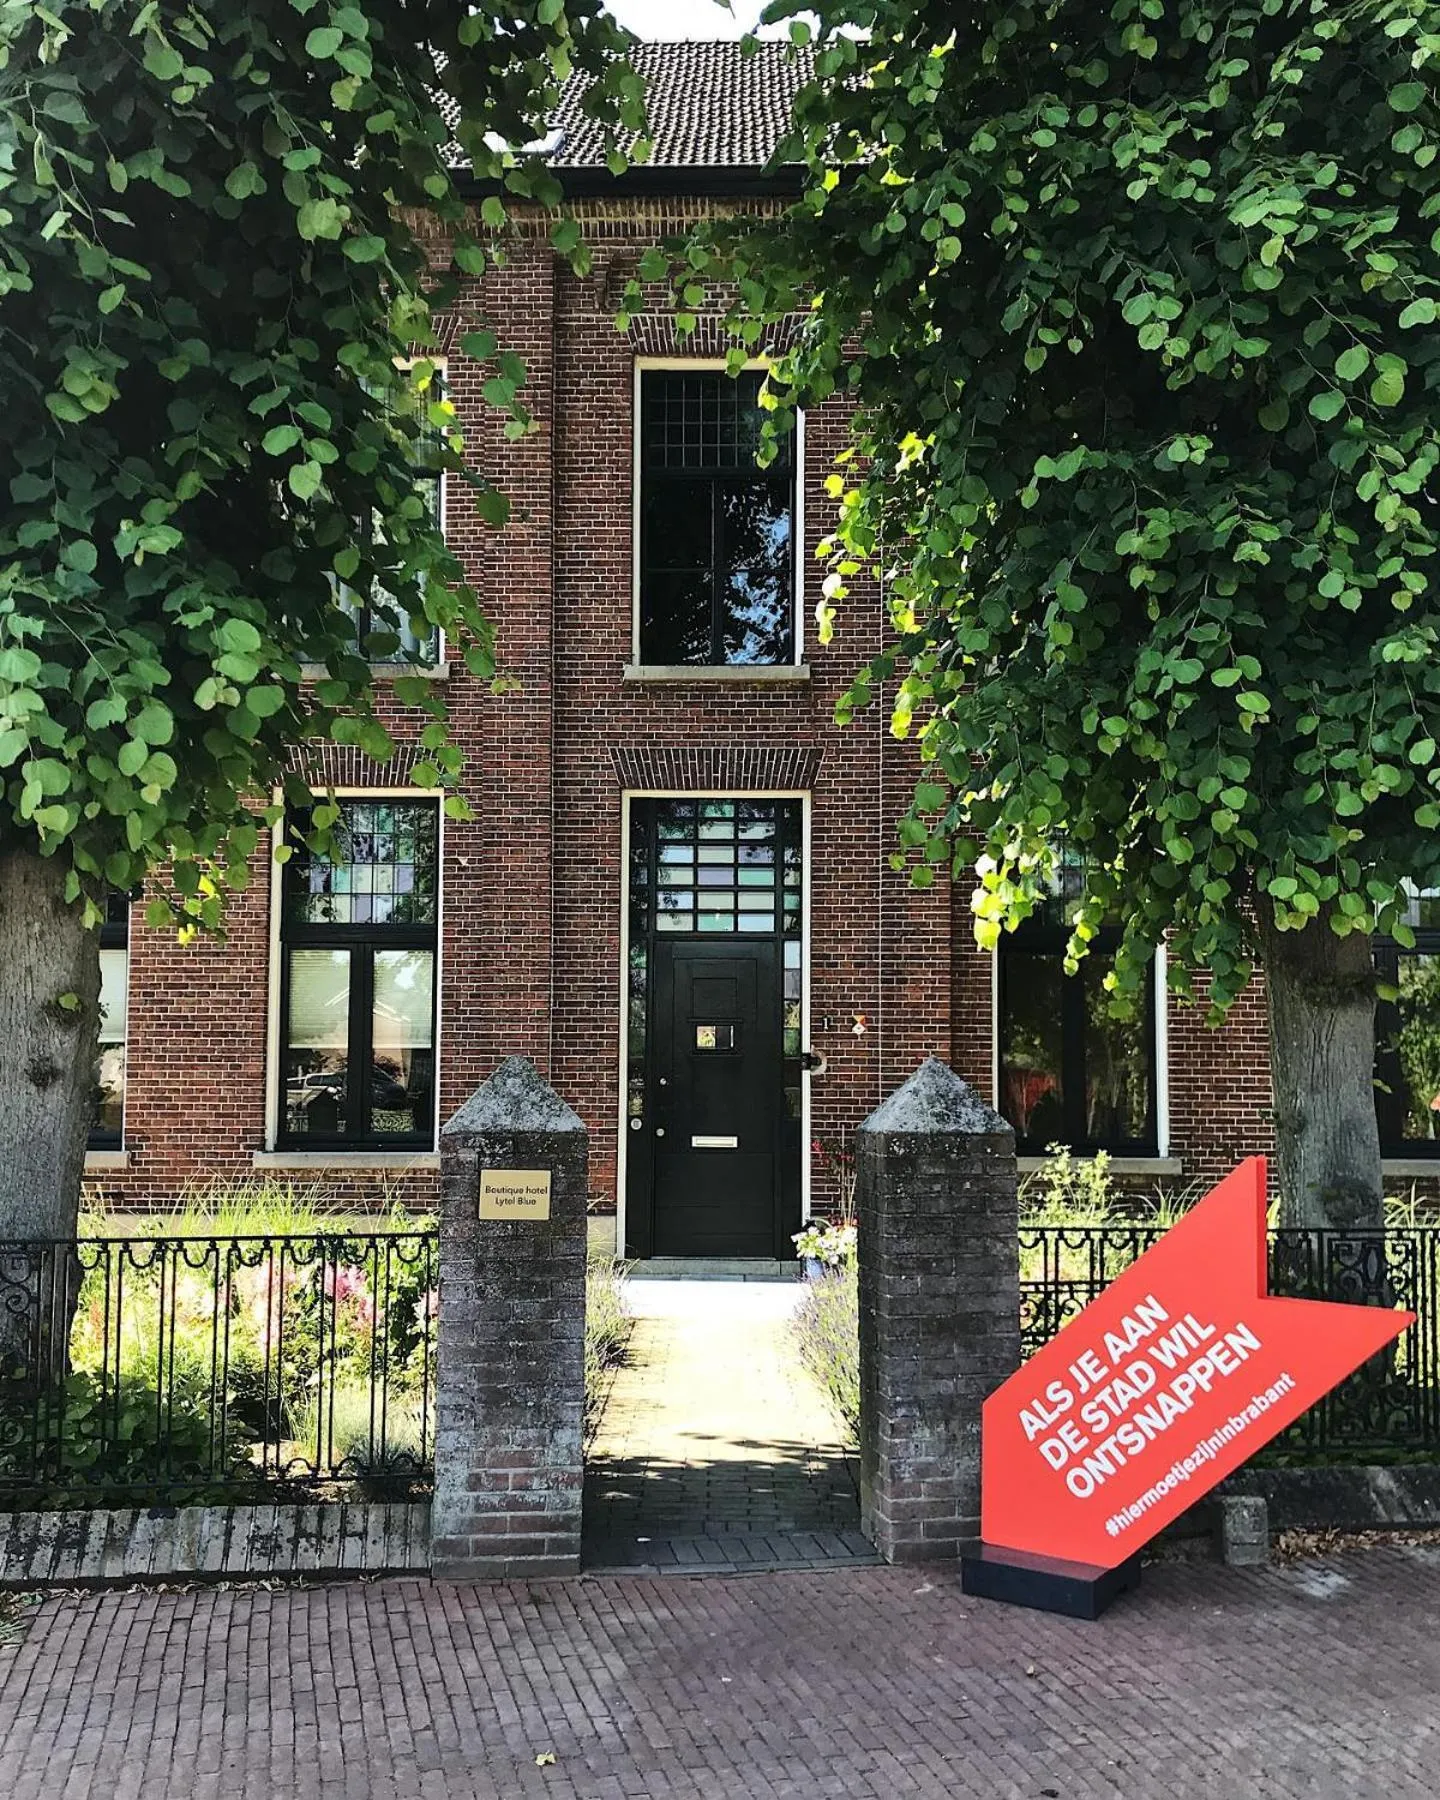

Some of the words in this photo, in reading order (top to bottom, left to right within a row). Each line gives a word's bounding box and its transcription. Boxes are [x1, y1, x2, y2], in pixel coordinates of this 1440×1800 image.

[485, 1185, 524, 1196] Boutique
[525, 1185, 548, 1195] hotel
[517, 1198, 537, 1206] Blue
[1018, 1380, 1074, 1441] ALS
[1067, 1348, 1110, 1394] JE
[1103, 1294, 1169, 1365] AAN
[1039, 1420, 1090, 1471] DE
[1081, 1360, 1157, 1434] STAD
[1147, 1313, 1217, 1369] WIL
[1066, 1322, 1262, 1498] ONTSNAPPEN
[1105, 1372, 1296, 1537] #hiermoetjezijninbrabant
